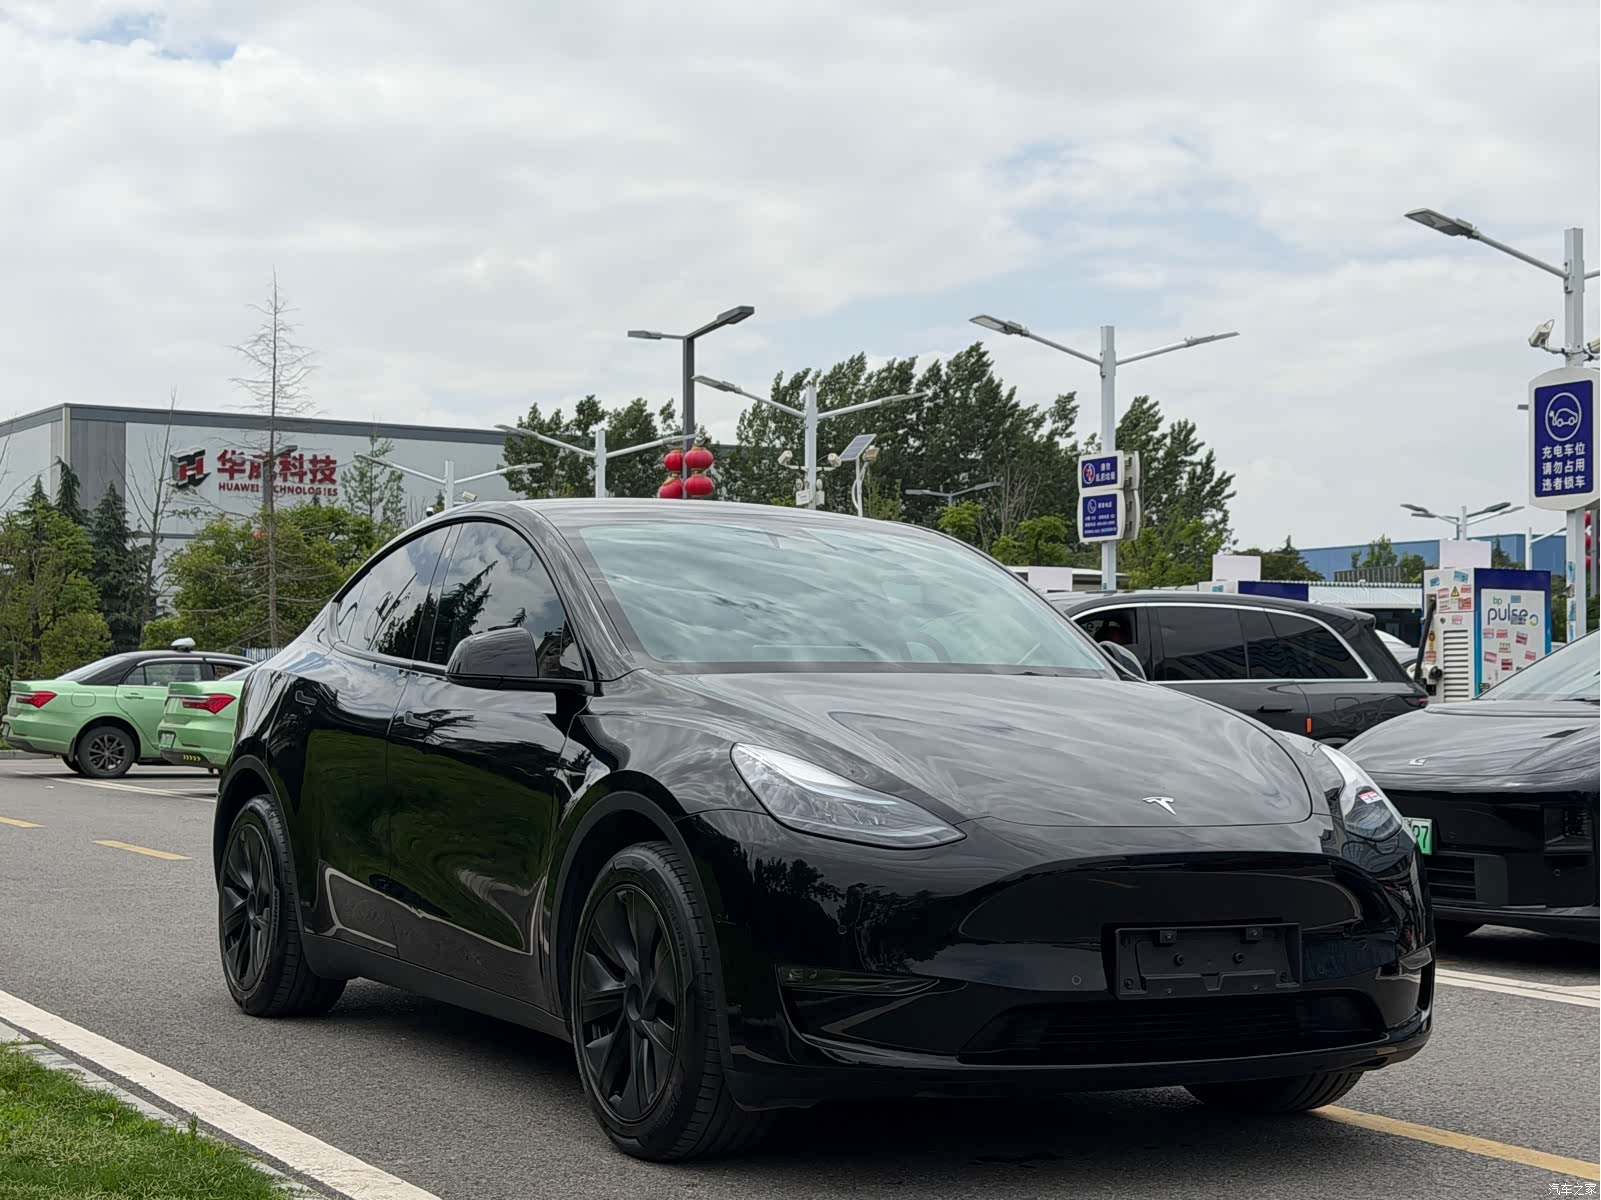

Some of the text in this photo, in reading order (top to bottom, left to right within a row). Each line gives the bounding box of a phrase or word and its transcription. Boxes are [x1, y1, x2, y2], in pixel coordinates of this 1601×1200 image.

[1542, 442, 1586, 459] 充电车位
[1542, 458, 1585, 475] 请勿占用
[218, 482, 338, 497] HUAWEI CHNOLOGIES
[1542, 475, 1586, 492] 违者锁车
[1492, 595, 1503, 605] bp
[1487, 603, 1528, 625] pulse
